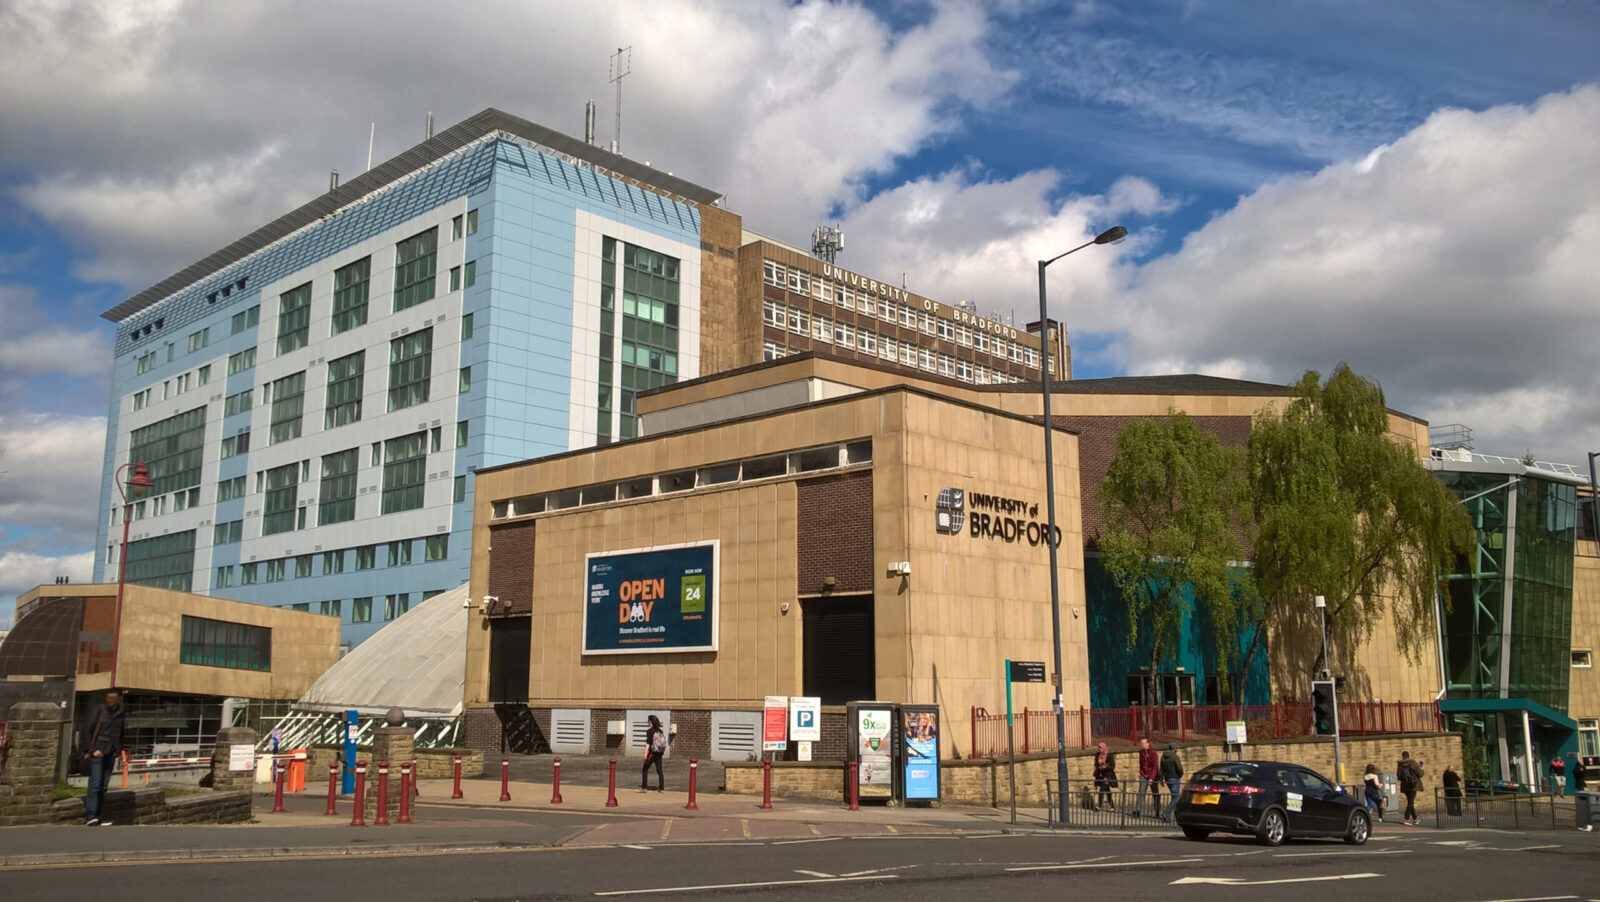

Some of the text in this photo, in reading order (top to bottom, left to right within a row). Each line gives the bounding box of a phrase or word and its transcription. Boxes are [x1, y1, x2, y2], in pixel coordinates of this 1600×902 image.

[823, 264, 1017, 339] UNIVERSITY OF BRADFORD
[969, 492, 1039, 519] UNIVERSITY of
[970, 511, 1062, 549] BRADFORD
[619, 578, 664, 602] OPEN
[686, 587, 701, 600] 24
[800, 711, 812, 727] P
[863, 718, 876, 730] 9x
